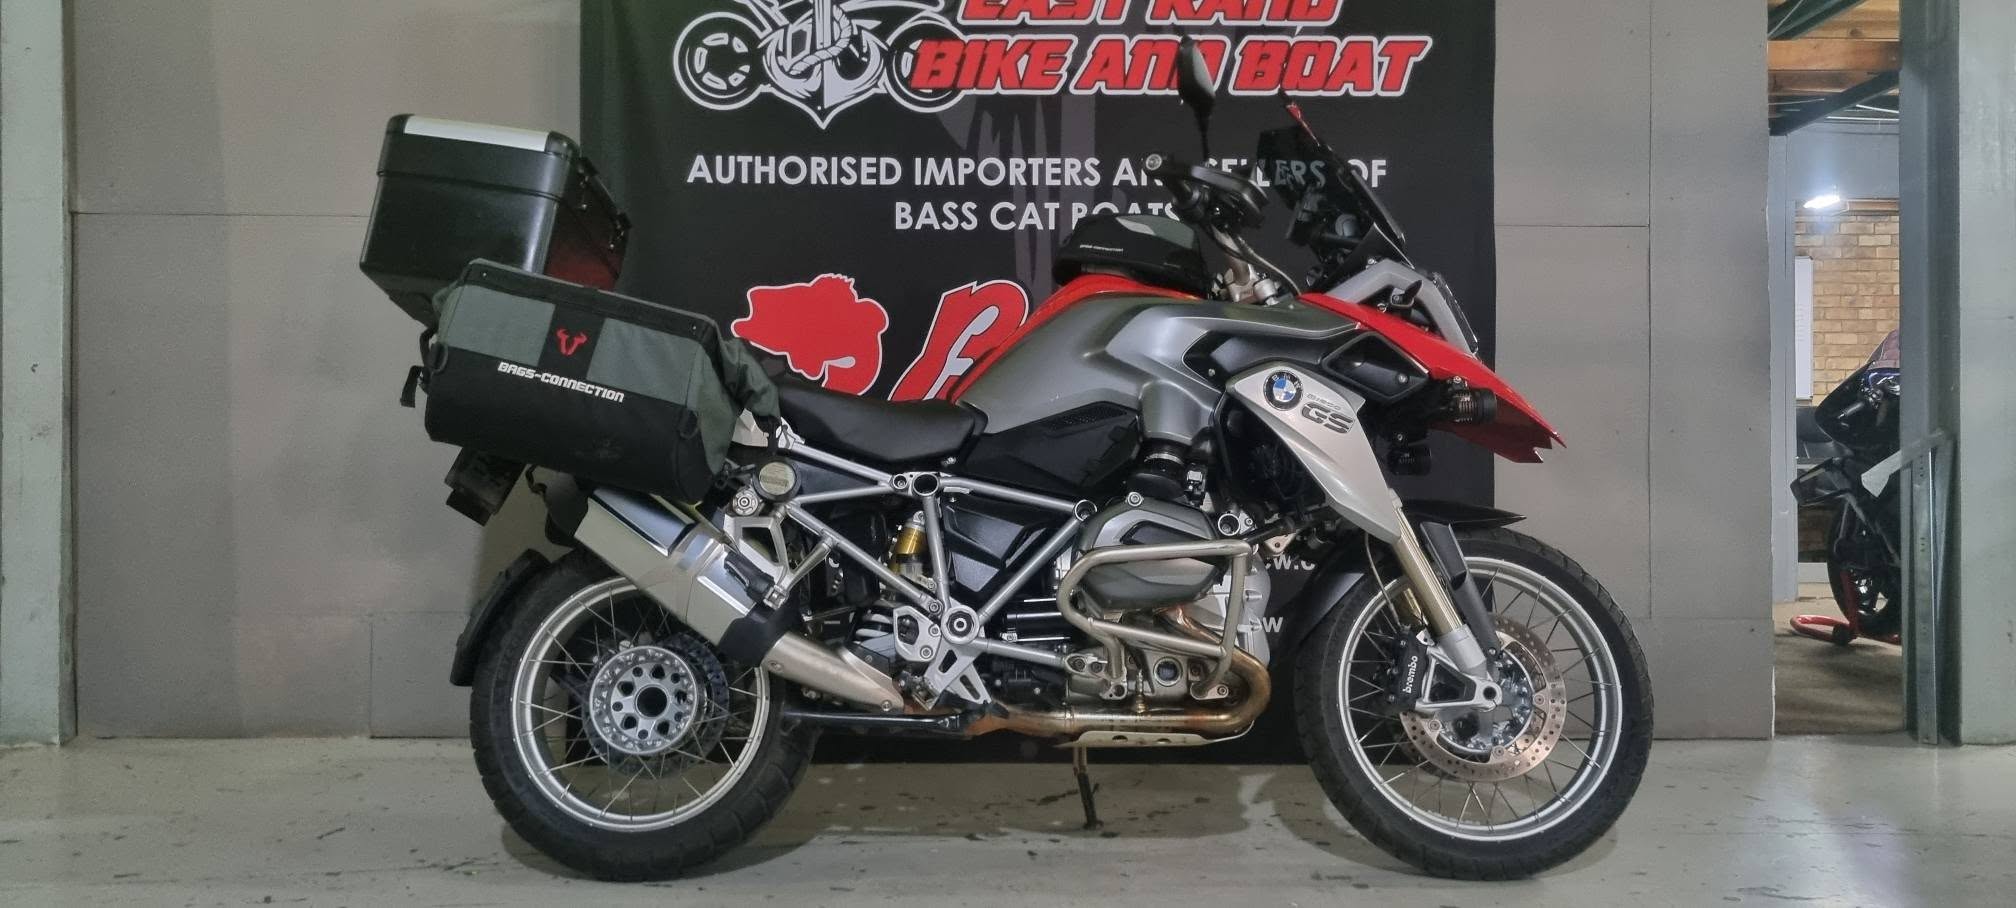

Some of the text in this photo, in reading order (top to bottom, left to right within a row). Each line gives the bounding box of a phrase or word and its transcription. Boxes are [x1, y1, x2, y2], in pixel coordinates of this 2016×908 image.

[910, 36, 1076, 92] BIKE
[1231, 37, 1430, 93] BOAT
[686, 154, 902, 187] AUTHORISED
[914, 156, 1101, 188] IMPORTERS
[895, 201, 978, 231] BASS
[990, 201, 1060, 231] CAT
[497, 361, 625, 403] BAGS-CONNECTION
[1301, 402, 1354, 434] GS
[1402, 655, 1418, 694] brembo
